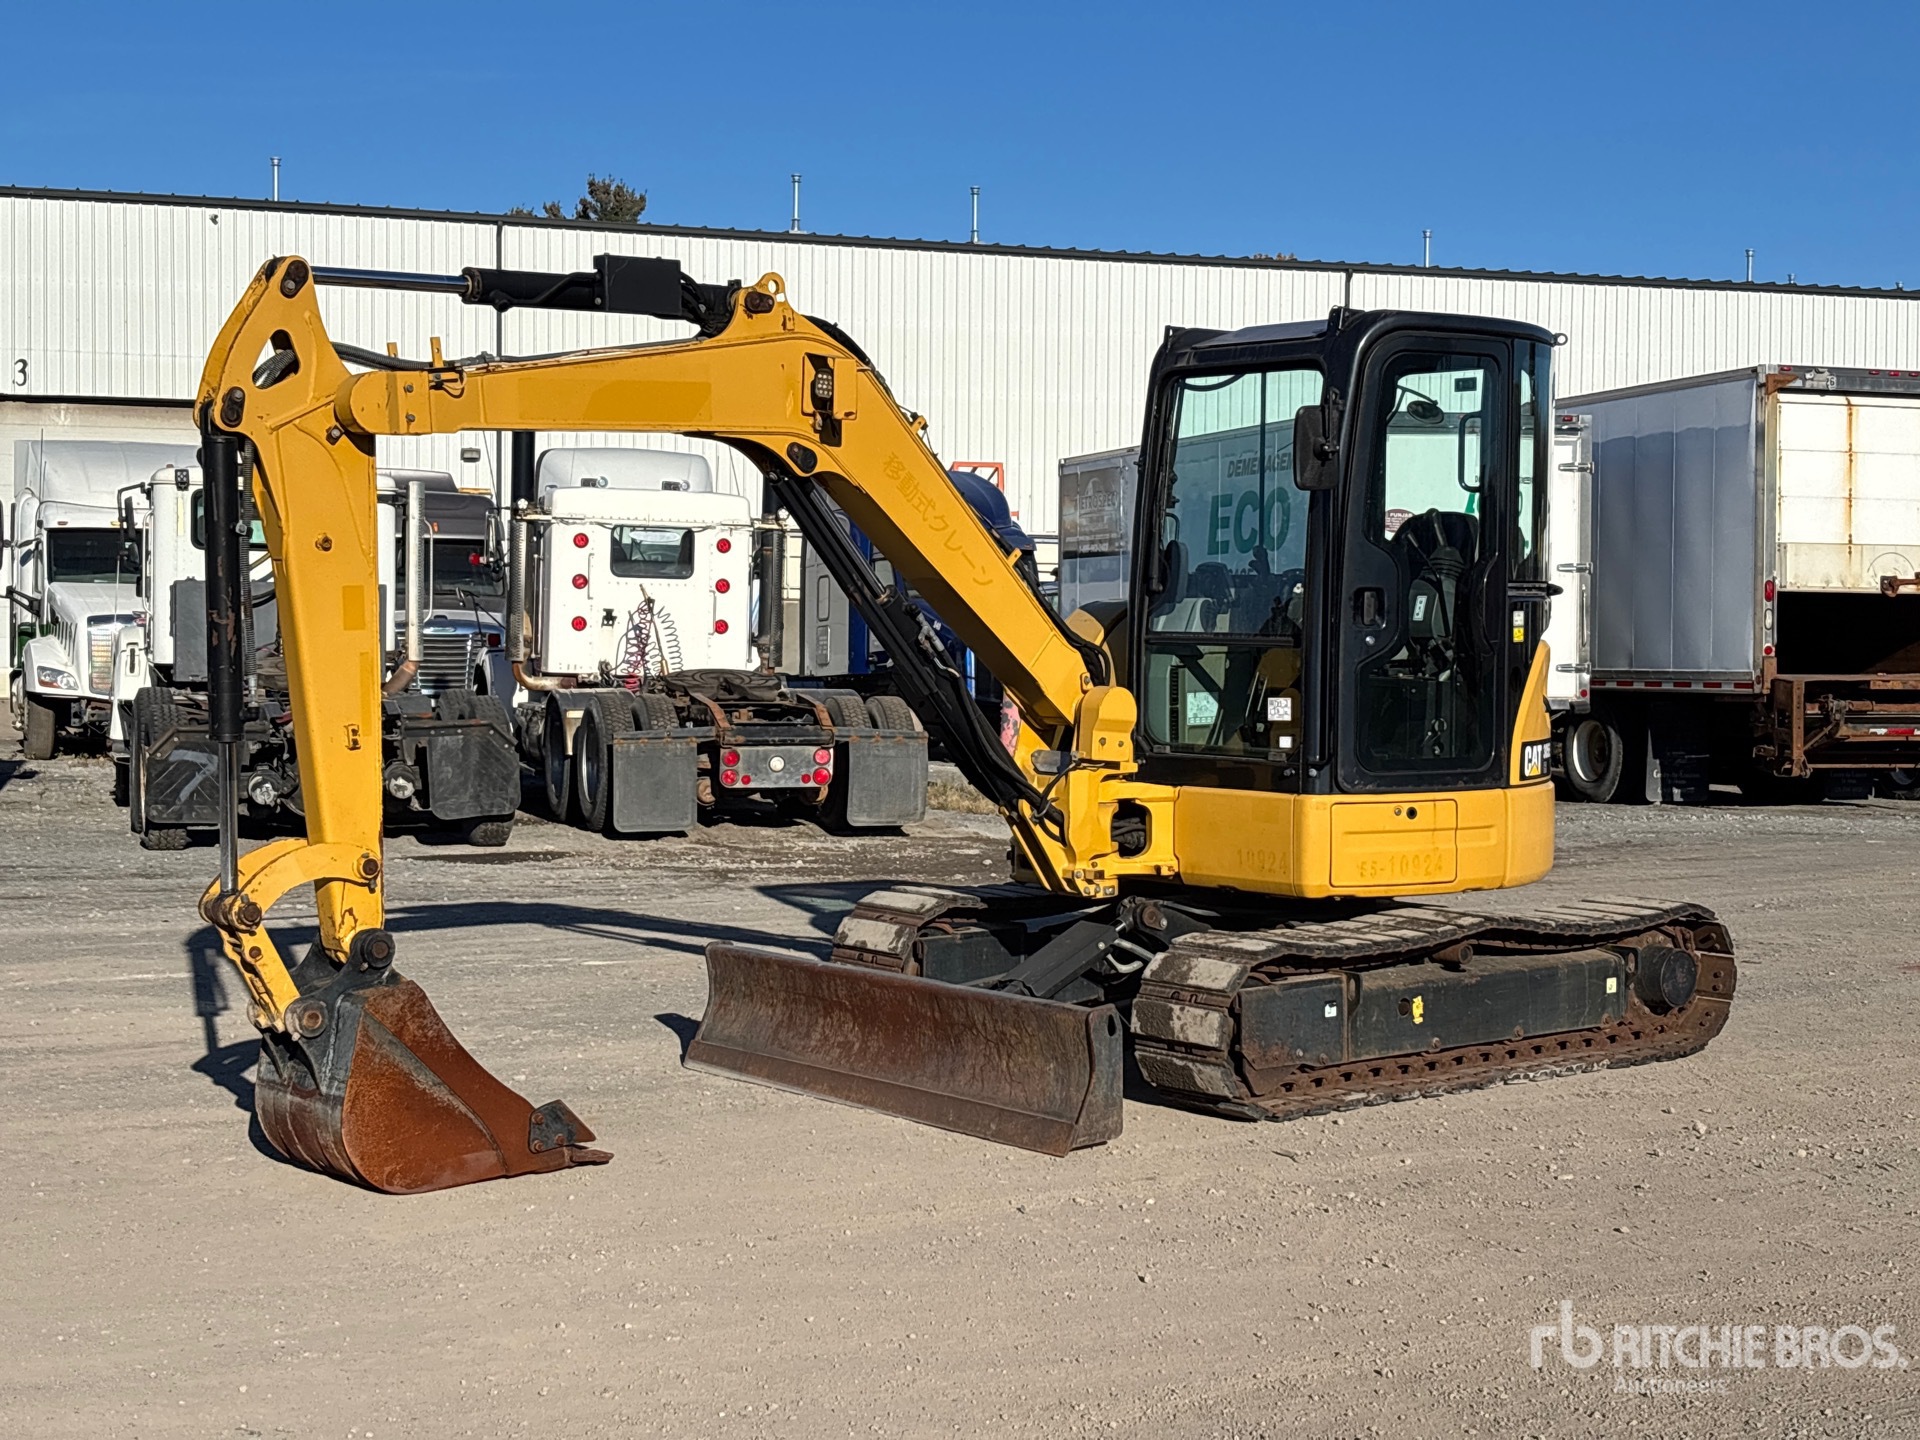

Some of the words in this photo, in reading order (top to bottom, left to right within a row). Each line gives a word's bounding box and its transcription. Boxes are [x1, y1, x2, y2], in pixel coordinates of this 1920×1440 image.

[12, 358, 28, 387] 3
[1226, 451, 1293, 478] DÉMÉAGE
[882, 452, 993, 586] 移動式クレーン
[1207, 486, 1291, 555] ECO
[1524, 744, 1542, 777] CAT
